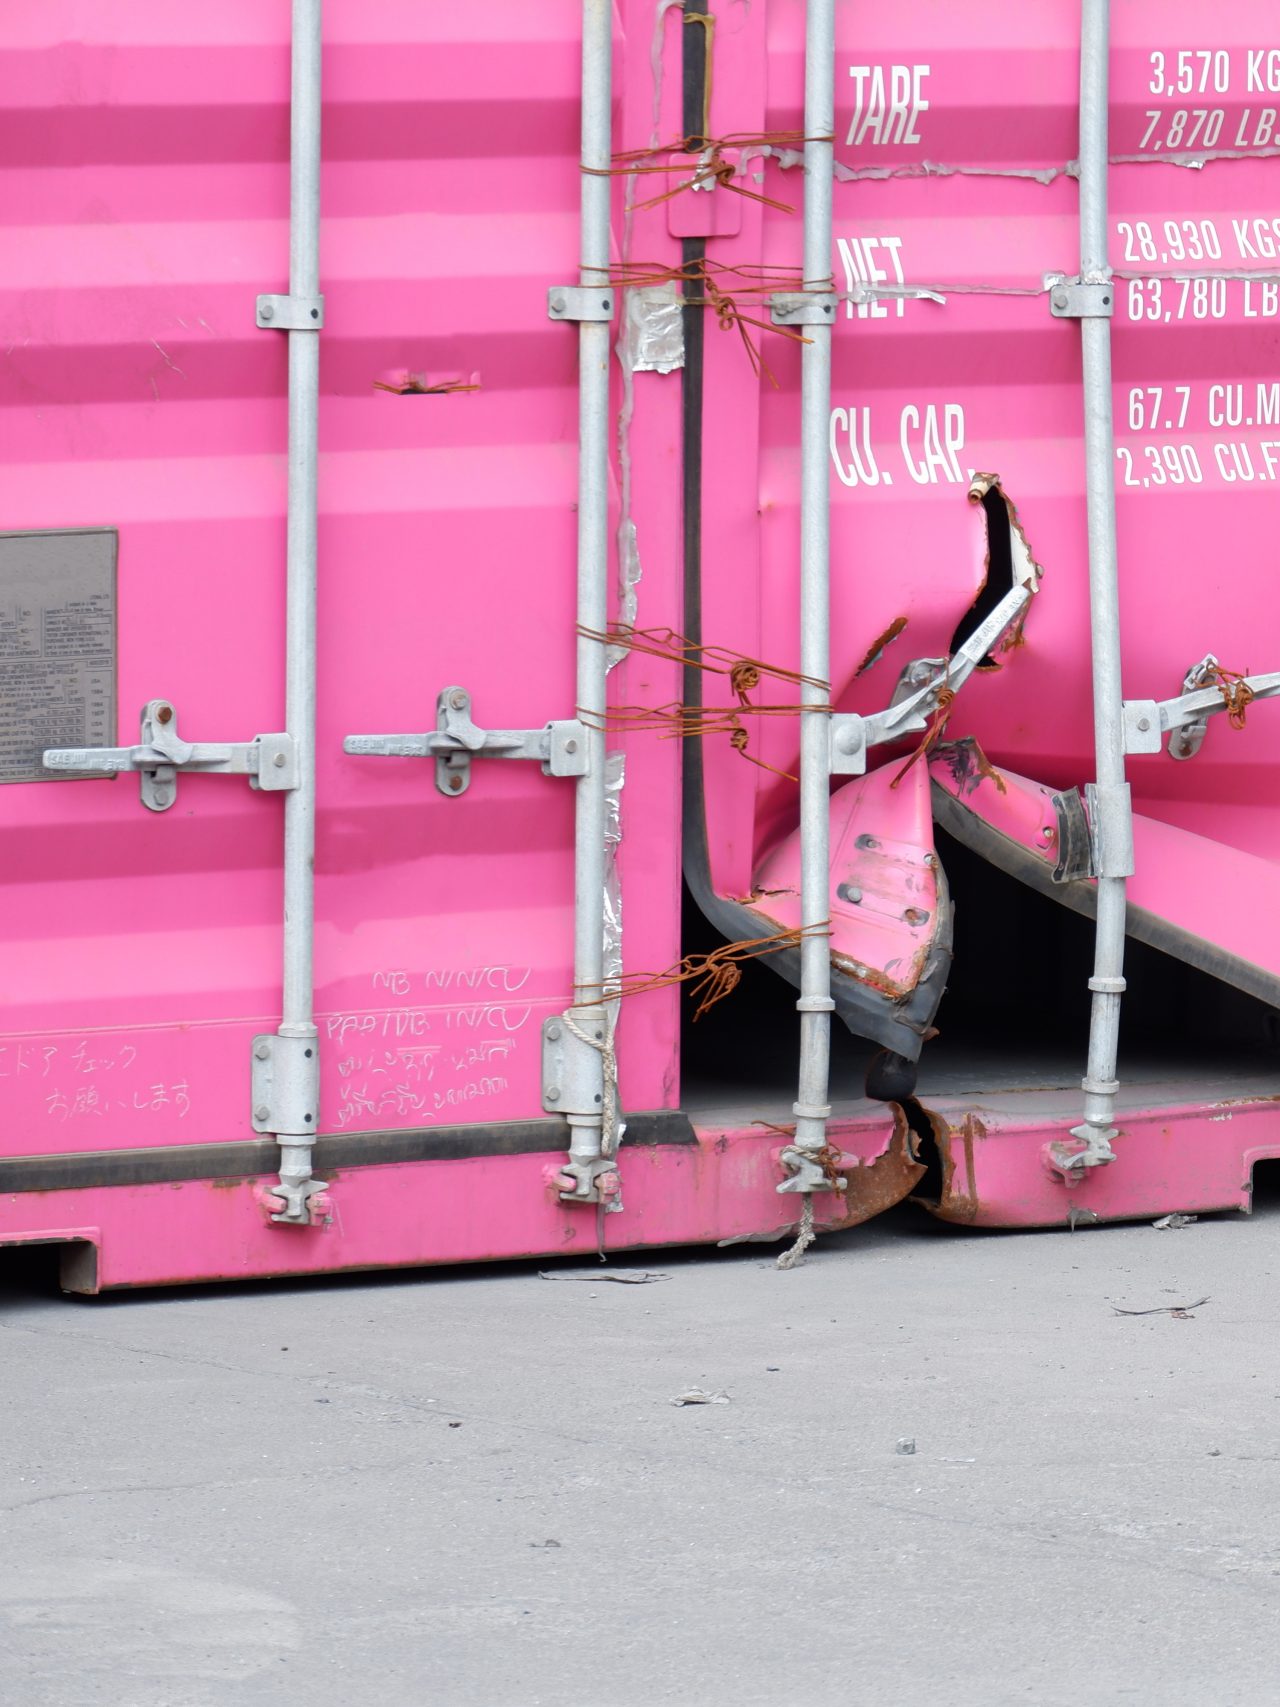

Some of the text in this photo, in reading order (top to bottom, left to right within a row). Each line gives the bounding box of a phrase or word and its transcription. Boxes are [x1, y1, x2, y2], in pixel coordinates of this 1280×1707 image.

[1149, 50, 1230, 97] 3,570
[846, 64, 931, 145] TARE
[1138, 109, 1225, 150] 7,870
[1117, 219, 1223, 265] 28,930
[837, 236, 904, 319] NET
[1127, 278, 1227, 322] 63,780
[1128, 386, 1191, 430] 67.7
[829, 402, 976, 488] CU. CAP.
[1116, 445, 1203, 487] 2,390
[44, 1079, 191, 1123] お願いします
